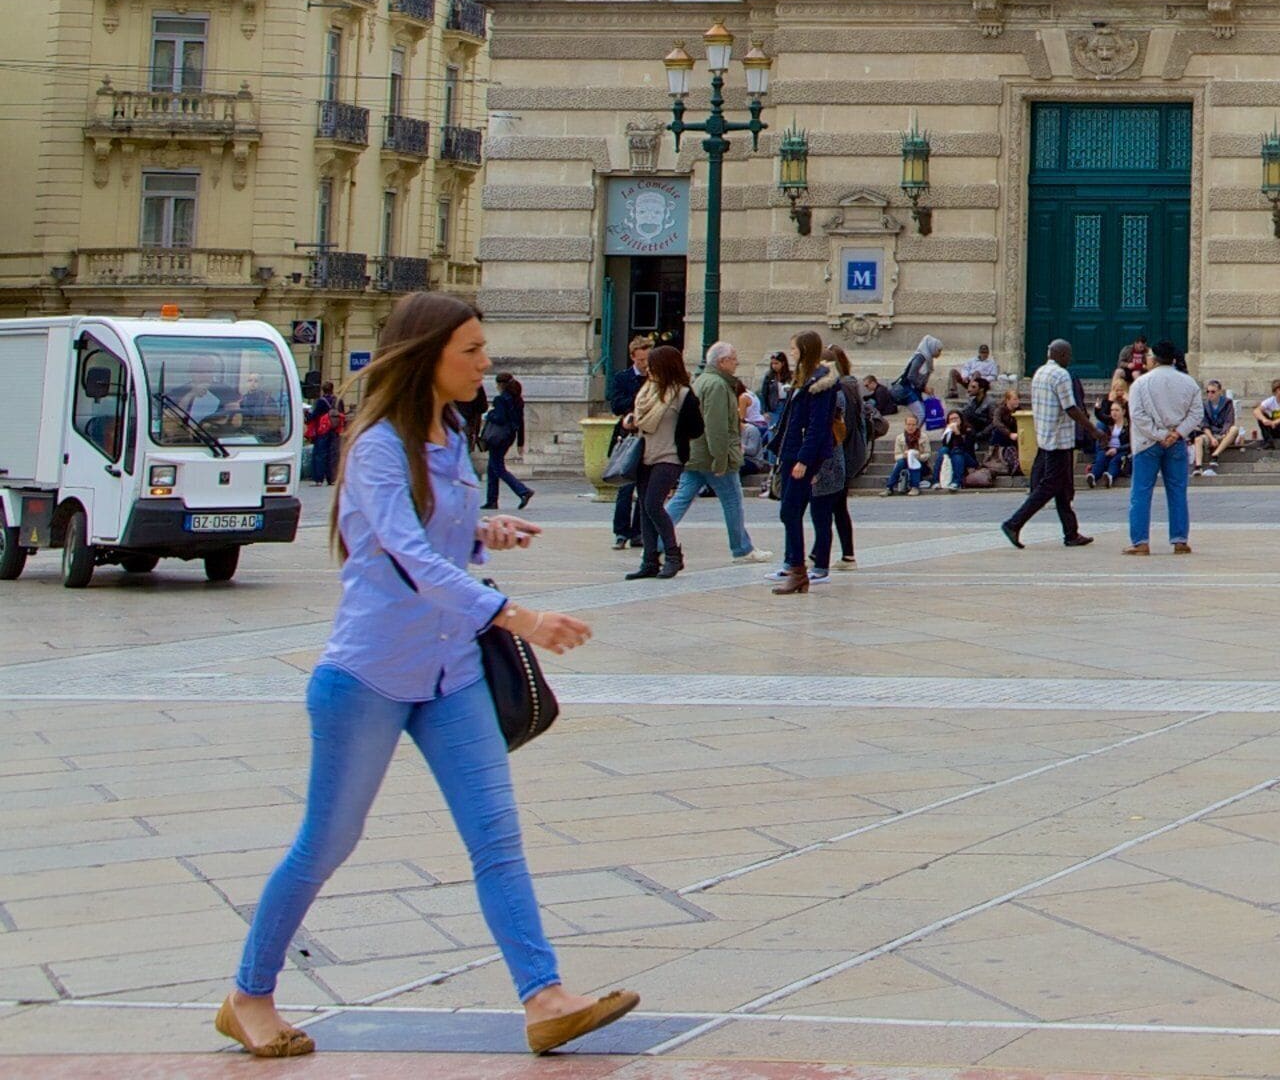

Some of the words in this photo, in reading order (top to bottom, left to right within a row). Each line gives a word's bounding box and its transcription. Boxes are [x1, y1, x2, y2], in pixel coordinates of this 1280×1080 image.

[621, 187, 635, 199] La
[620, 232, 678, 252] Billetterie
[853, 270, 871, 287] M
